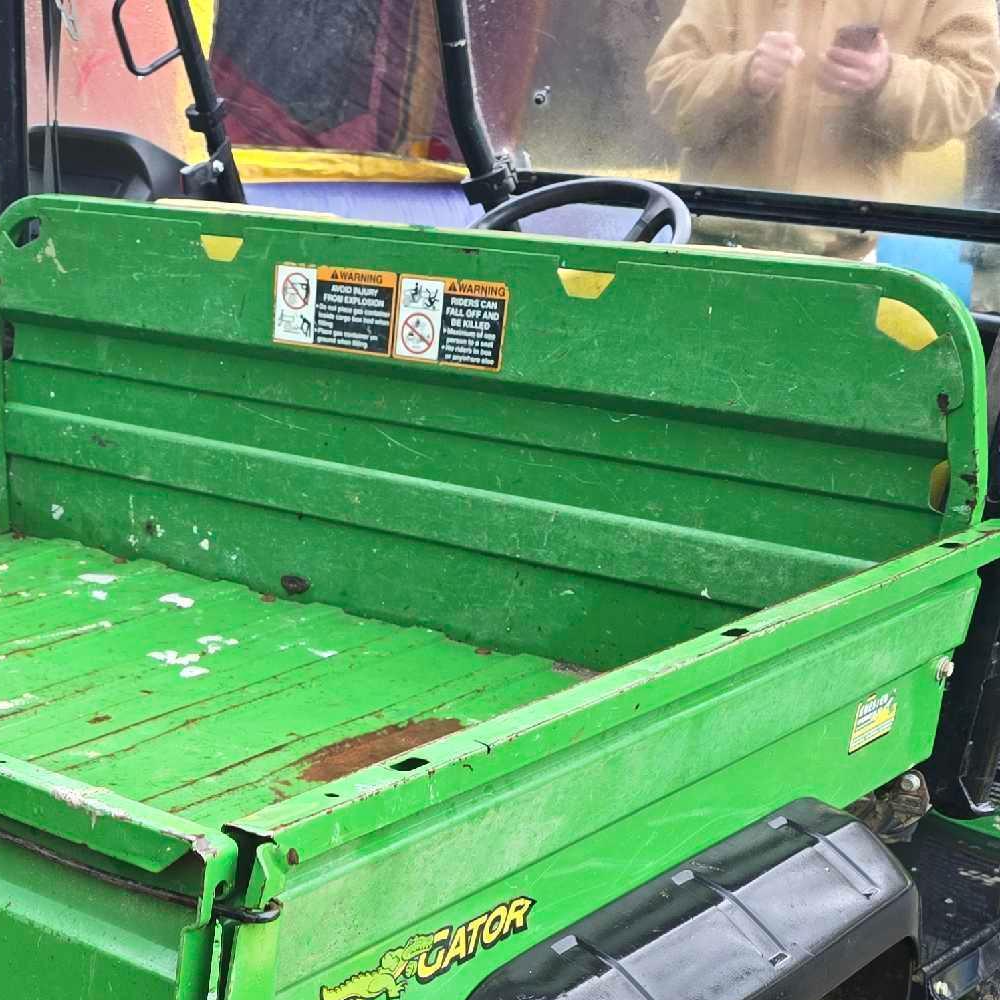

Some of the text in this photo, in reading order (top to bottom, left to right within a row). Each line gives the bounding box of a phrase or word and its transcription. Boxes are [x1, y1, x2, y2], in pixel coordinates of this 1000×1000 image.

[340, 271, 383, 285] WARNING
[331, 284, 379, 297] AVOID INJURY
[459, 282, 505, 297] WARNING
[323, 293, 385, 308] FROM EXPLOSION
[451, 297, 498, 309] RIDERS CAN
[446, 306, 500, 321] FALL OFF AND
[451, 317, 491, 331] BE KILLED
[415, 897, 536, 982] GATOR
